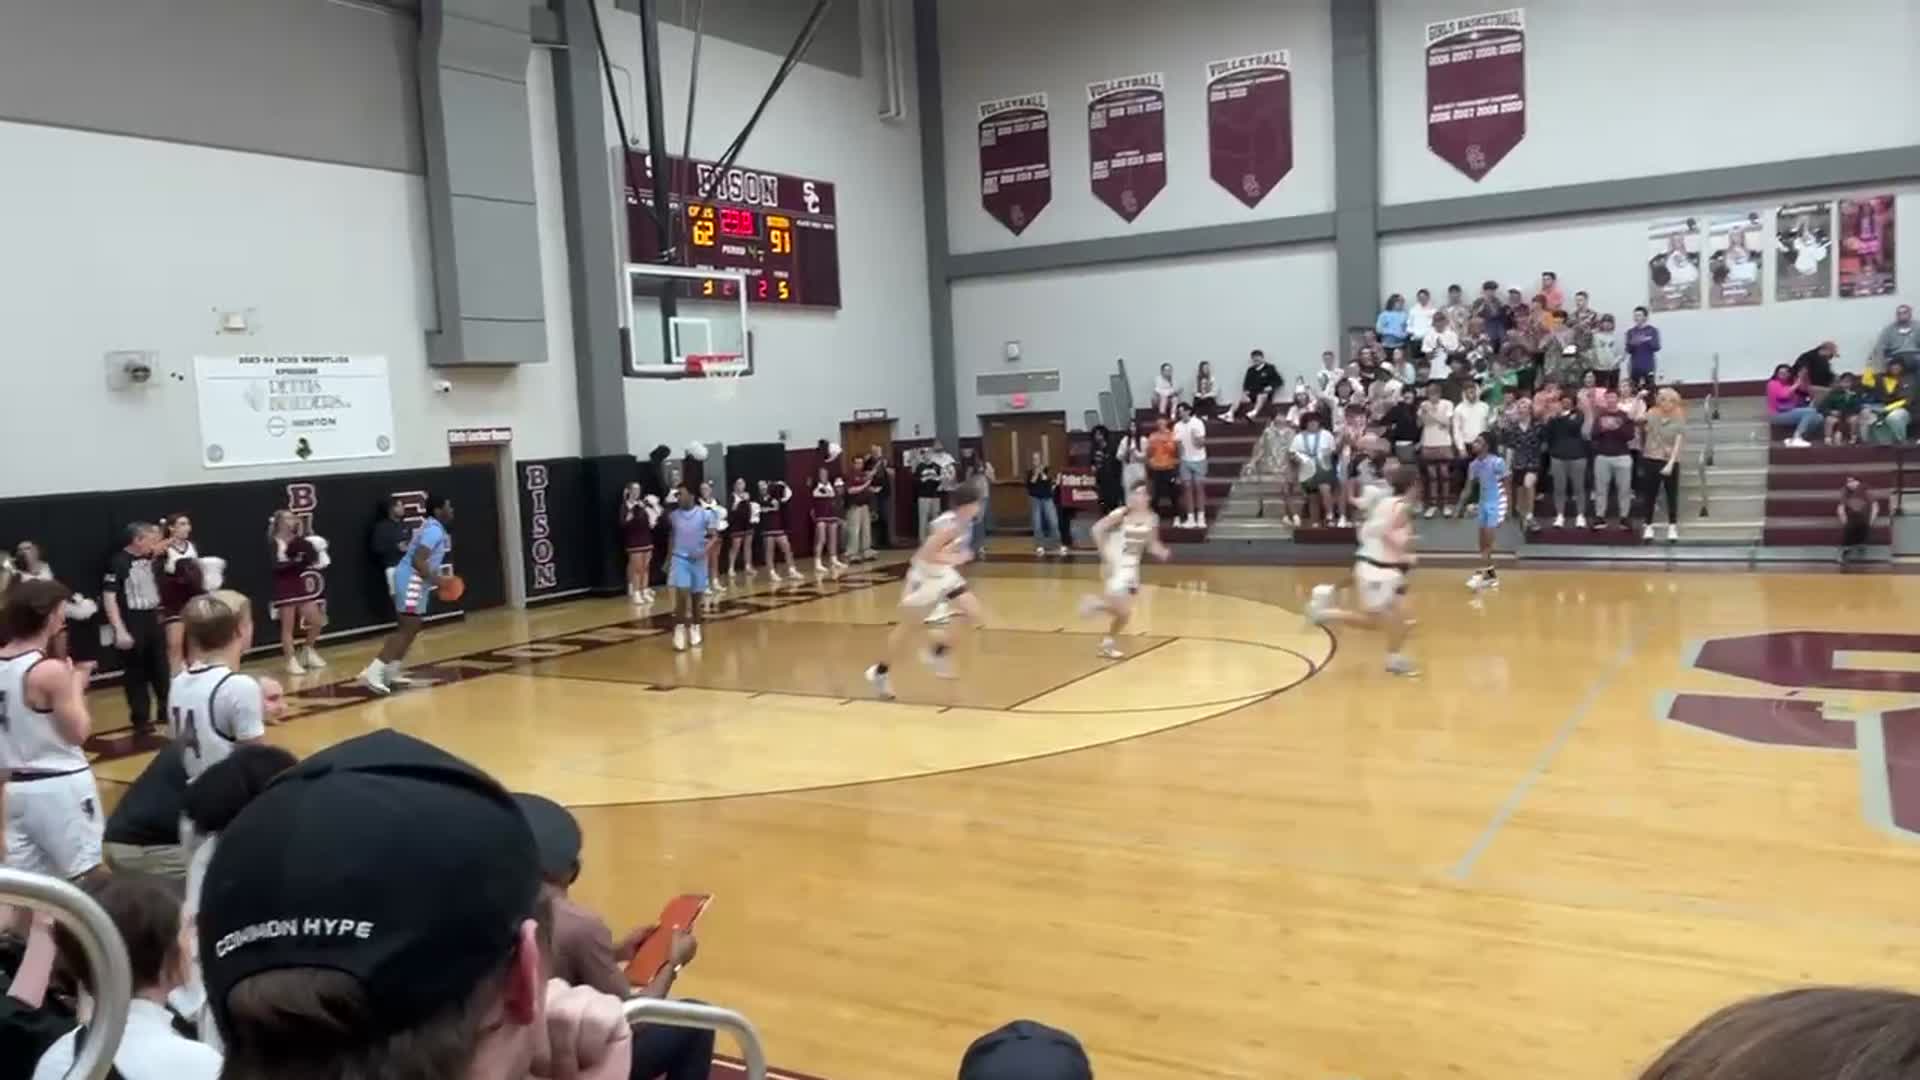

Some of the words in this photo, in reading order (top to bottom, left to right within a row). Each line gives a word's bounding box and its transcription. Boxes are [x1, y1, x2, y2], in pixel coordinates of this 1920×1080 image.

[1428, 21, 1455, 40] GIRLS
[1208, 51, 1287, 77] VOLLEYBALL
[1088, 74, 1161, 98] VOLLEYBALL
[980, 95, 1046, 117] VOLLEYBALL
[692, 220, 714, 246] 62
[770, 230, 791, 253] 91
[778, 281, 790, 299] 5
[526, 465, 557, 588] BISON
[215, 918, 298, 957] COMMON
[303, 917, 374, 938] HYPE
